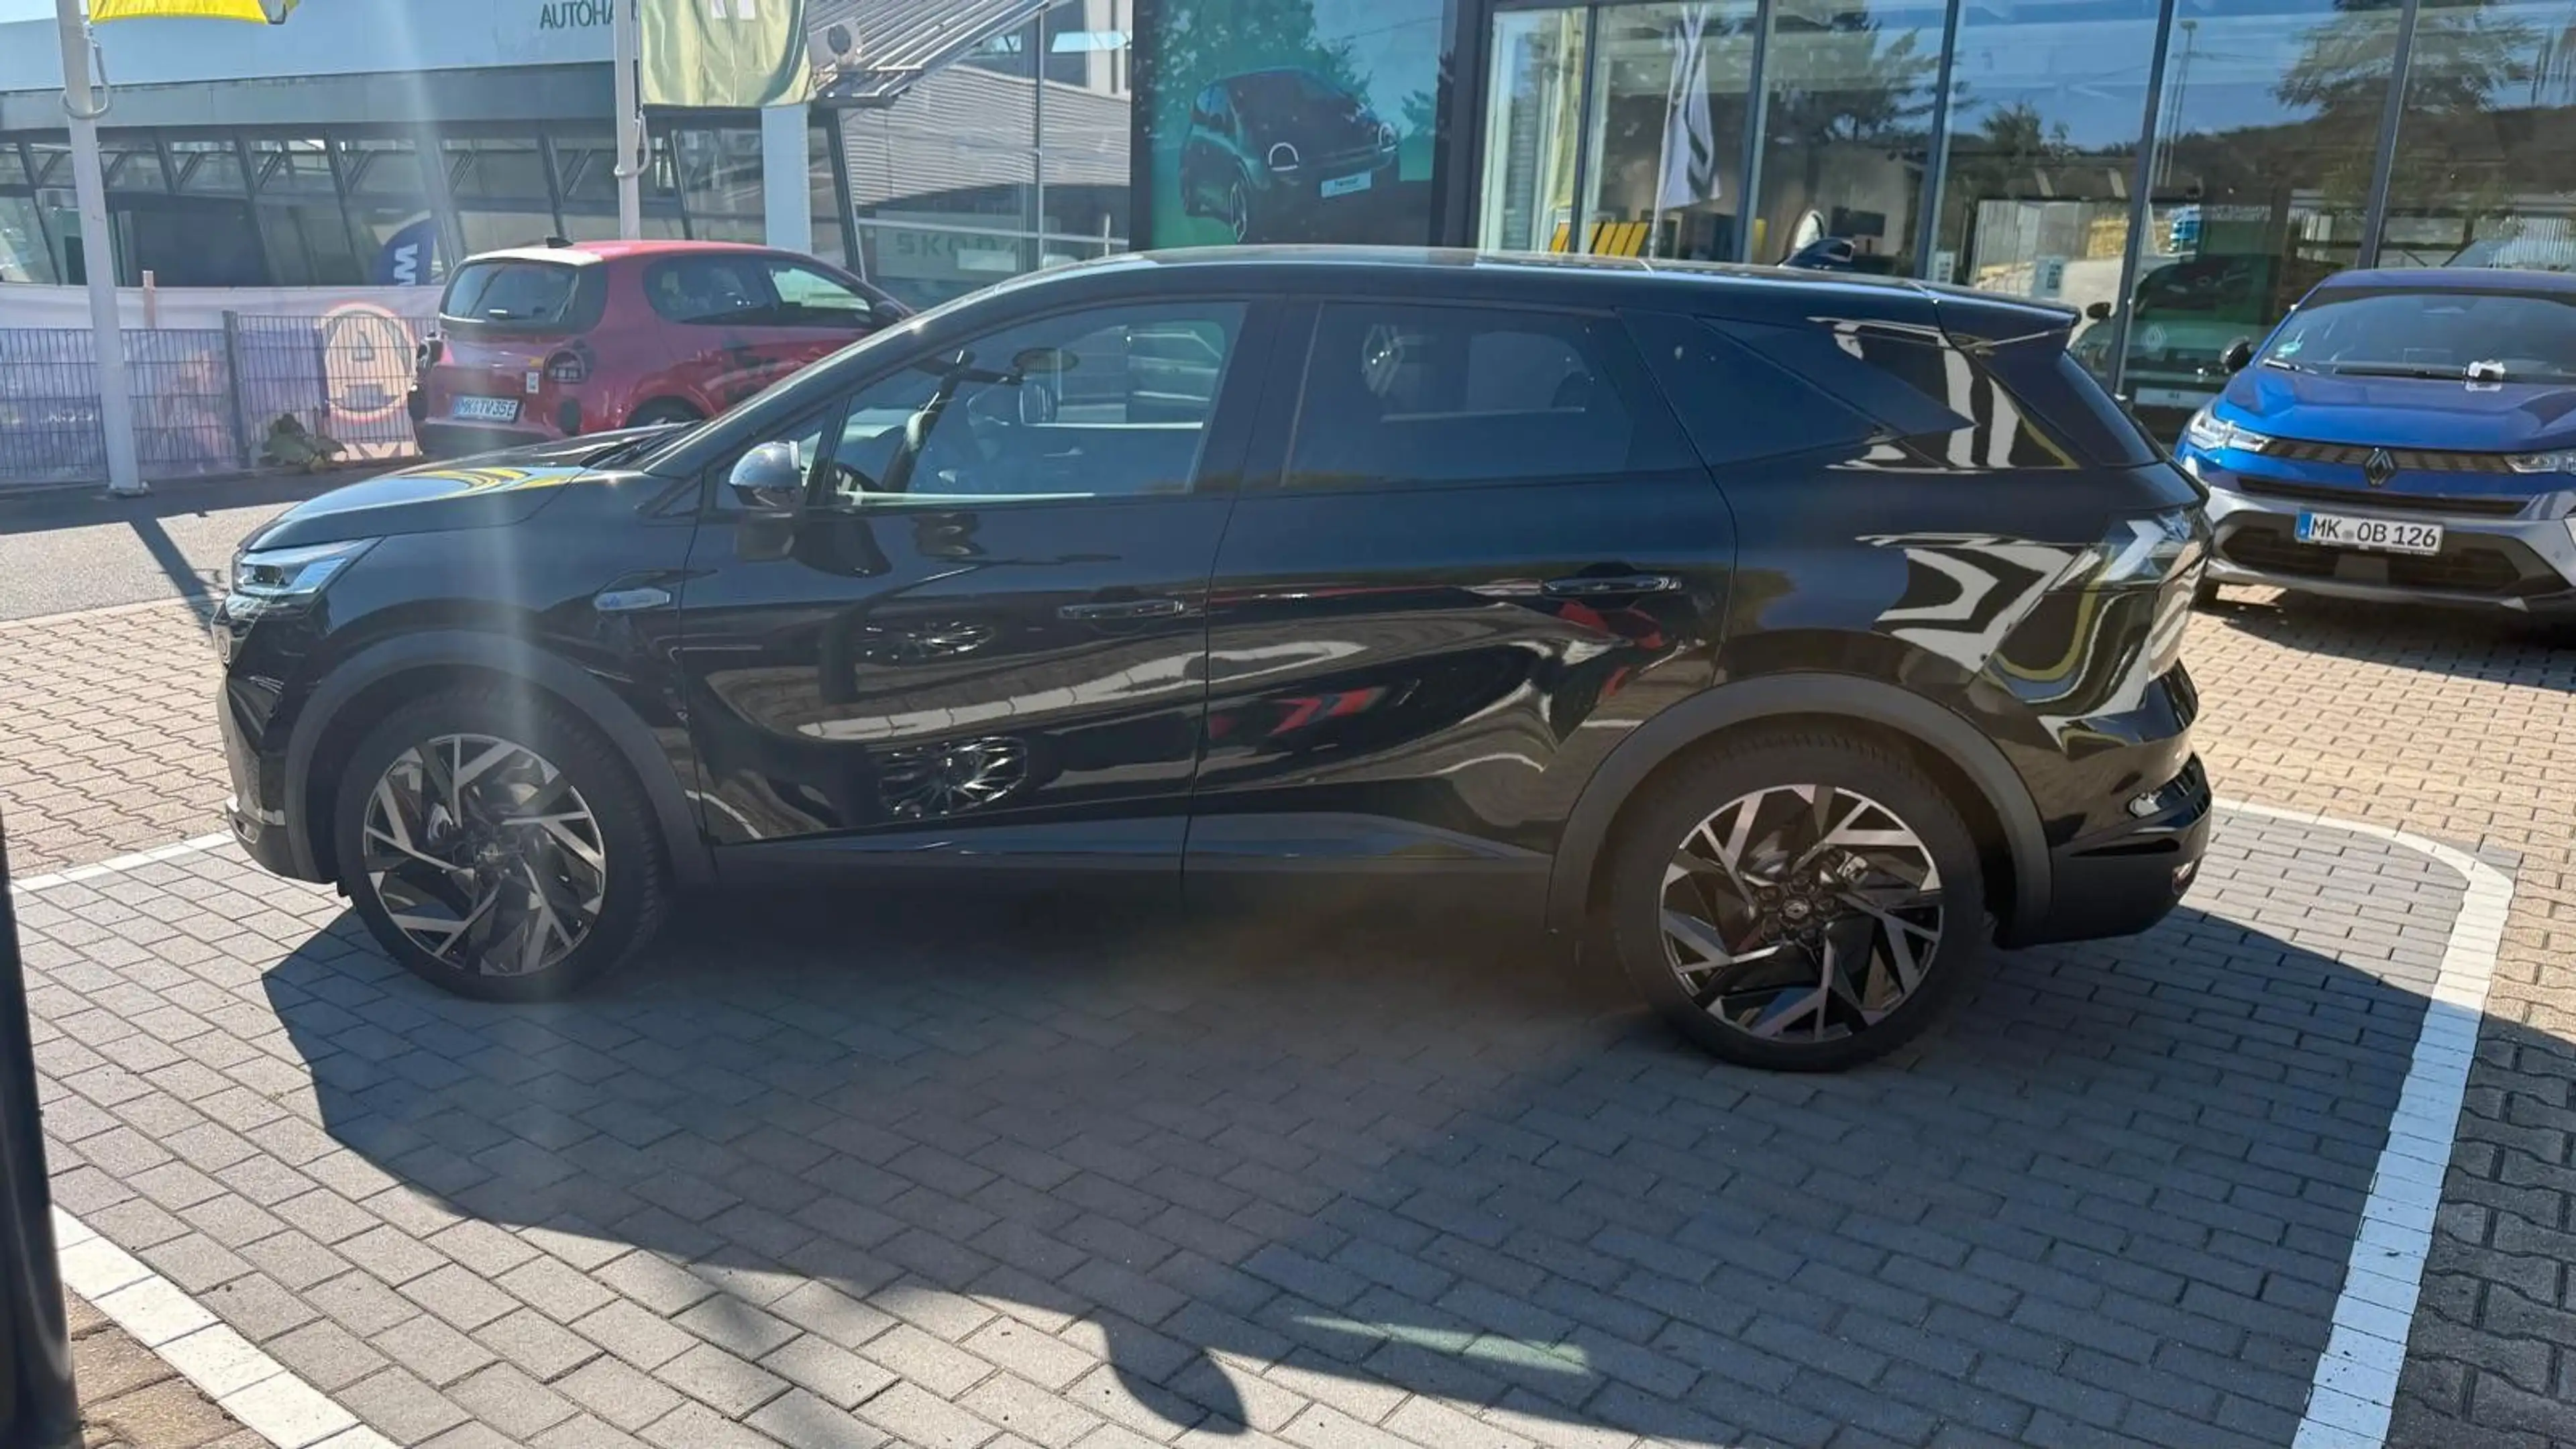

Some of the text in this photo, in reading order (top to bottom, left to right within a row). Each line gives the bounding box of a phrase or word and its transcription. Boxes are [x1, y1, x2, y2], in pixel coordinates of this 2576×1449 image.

[2312, 517, 2436, 547] MK OB 126
